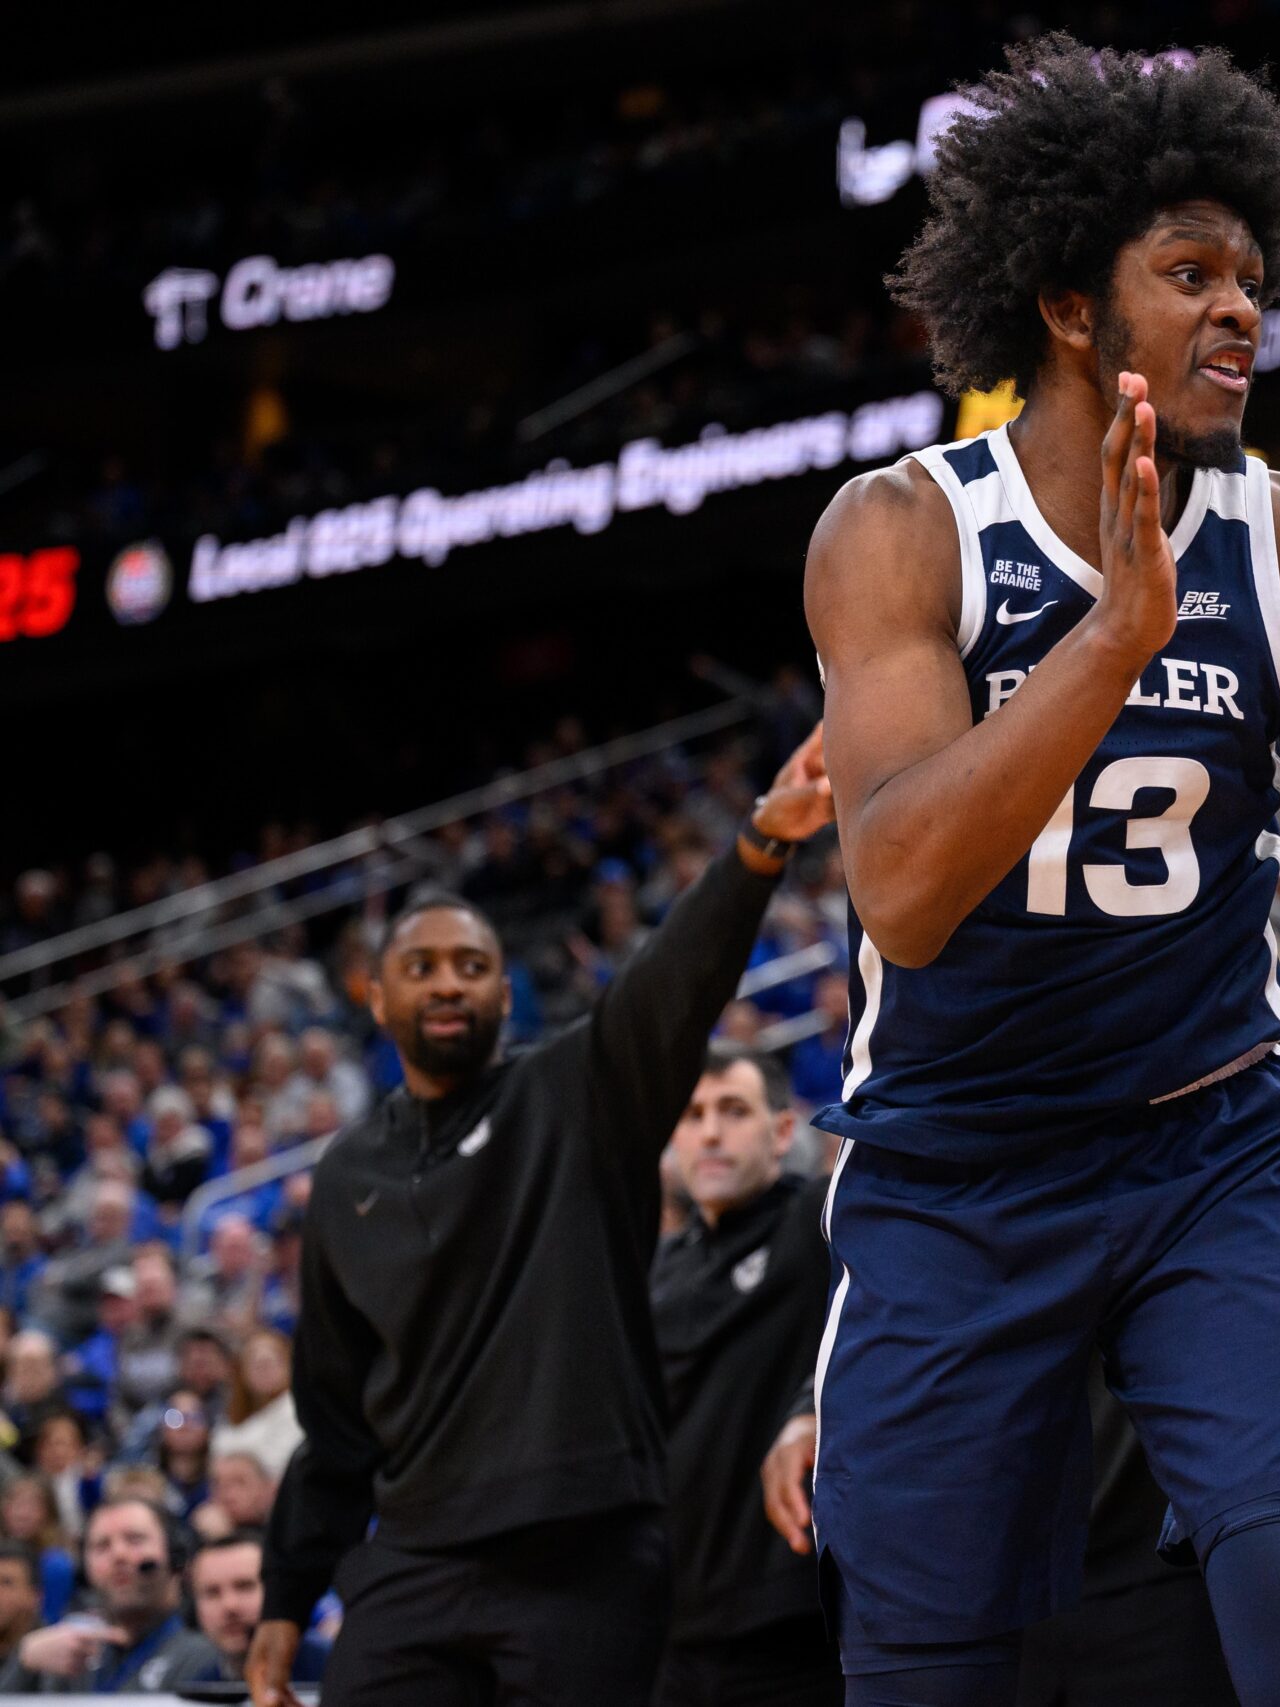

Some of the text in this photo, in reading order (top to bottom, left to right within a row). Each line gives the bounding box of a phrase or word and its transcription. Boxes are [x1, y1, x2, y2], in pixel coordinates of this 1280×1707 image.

[189, 515, 304, 602] Local
[398, 458, 613, 567] Operating
[616, 410, 848, 514] Engineers
[996, 560, 1040, 578] BE THE
[990, 571, 1042, 591] CHANGE
[1182, 591, 1220, 604] BIG
[1177, 603, 1231, 616] EAST
[984, 657, 1245, 720] BLER
[1026, 756, 1211, 917] 13
